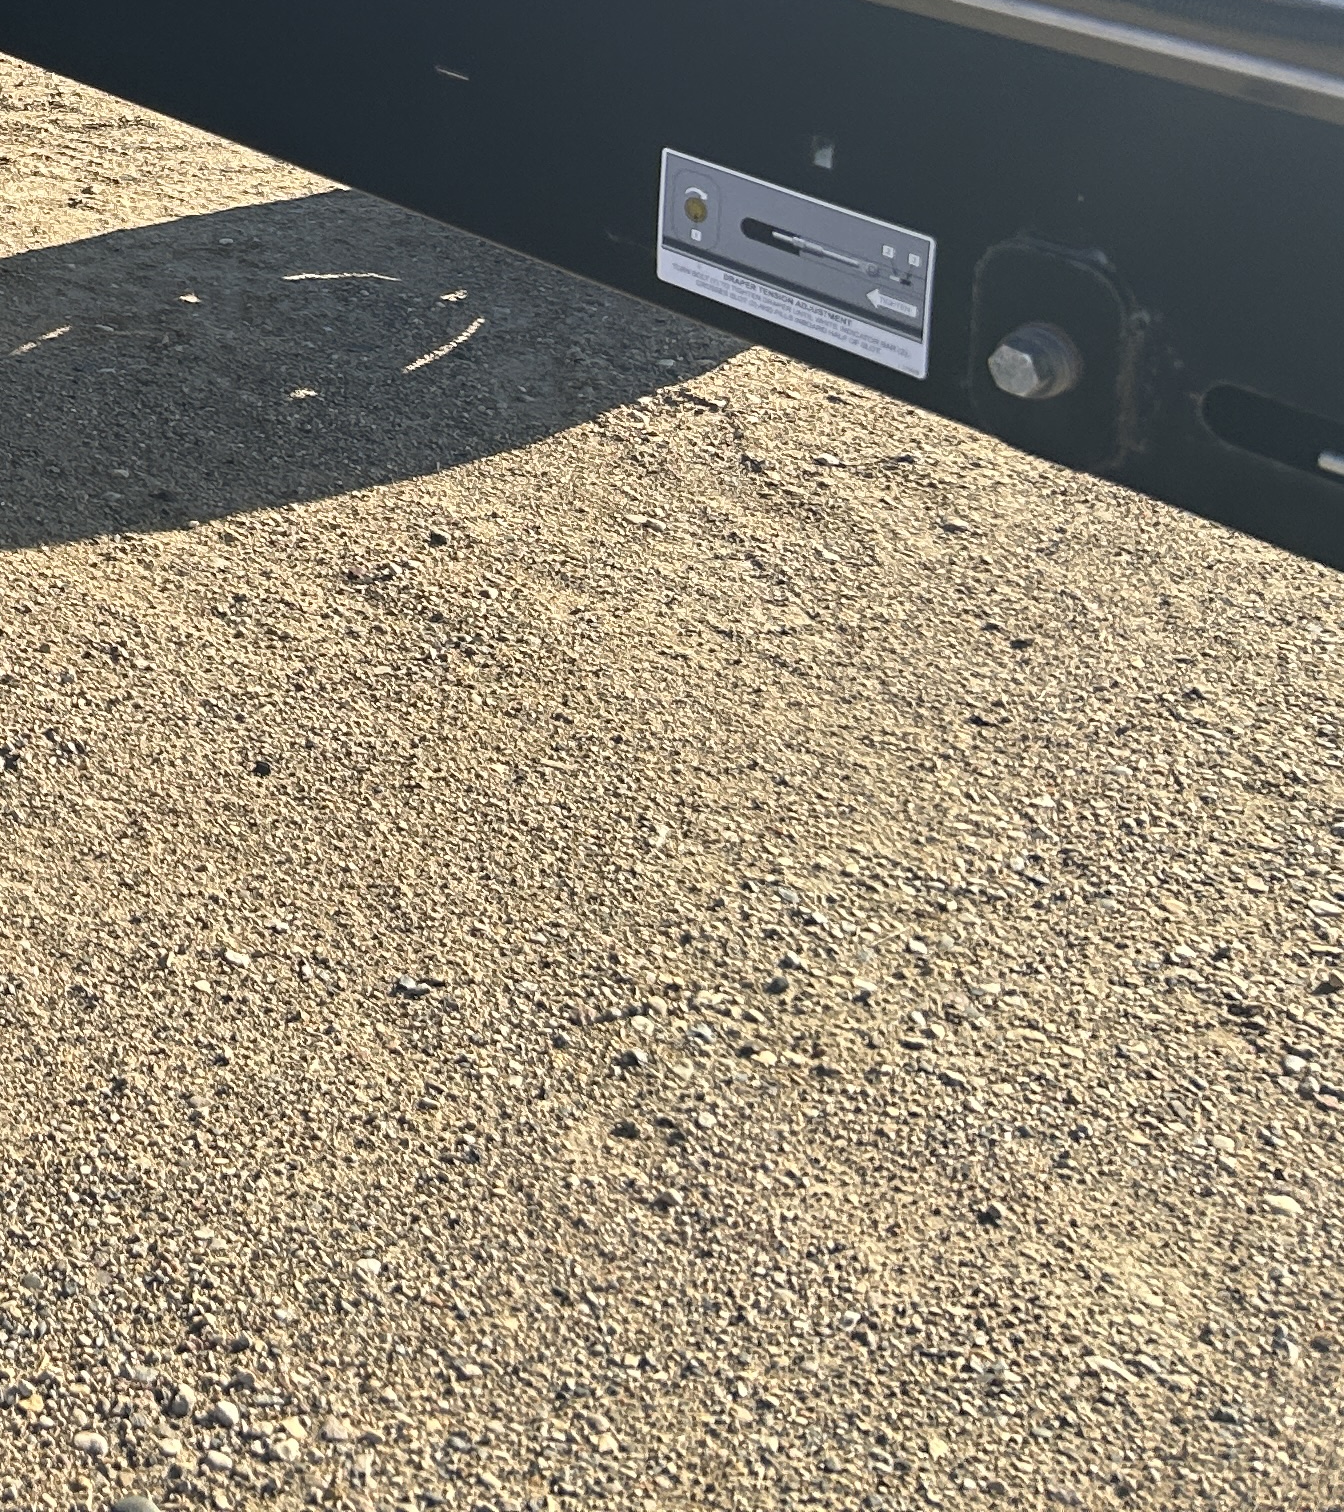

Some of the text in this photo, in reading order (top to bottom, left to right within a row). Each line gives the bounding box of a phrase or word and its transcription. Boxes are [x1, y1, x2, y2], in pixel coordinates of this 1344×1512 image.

[723, 273, 852, 326] DRAPER TENSION ADJUSTMENT
